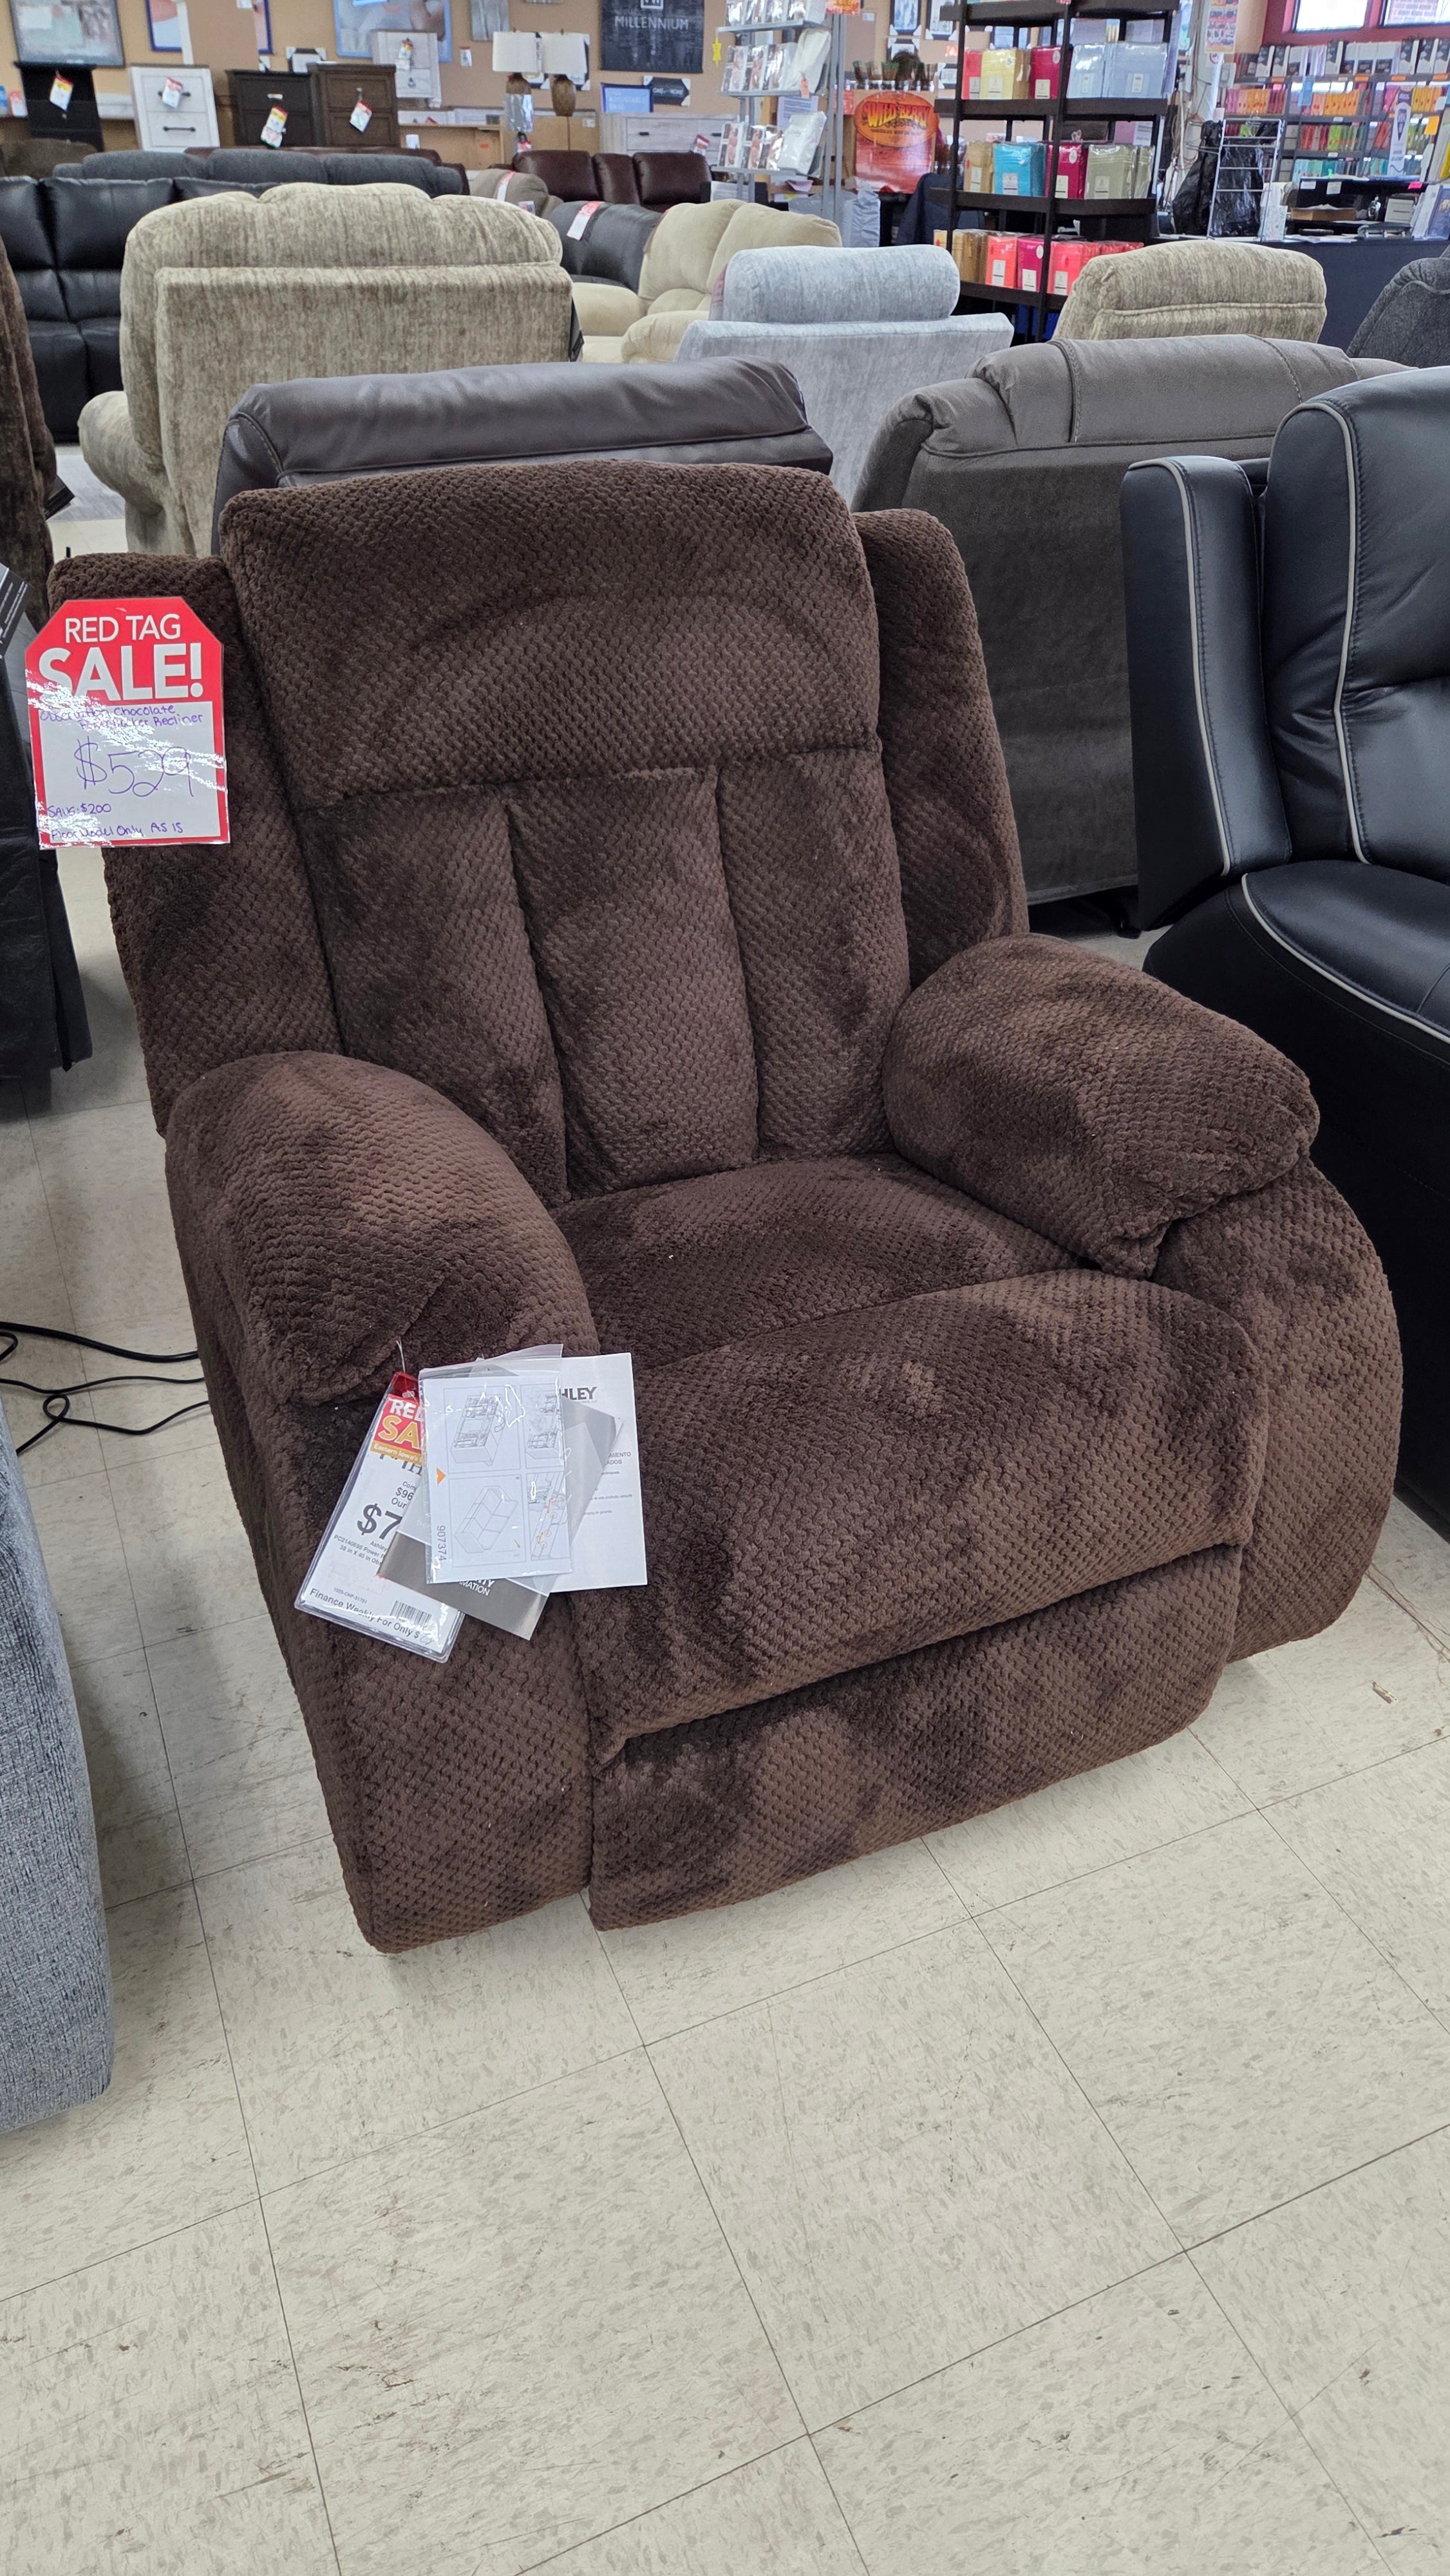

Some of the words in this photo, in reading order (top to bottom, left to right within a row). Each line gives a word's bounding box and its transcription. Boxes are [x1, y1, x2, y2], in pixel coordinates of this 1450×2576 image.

[614, 15, 690, 30] MILLENNIUM
[66, 617, 118, 643] RED
[126, 614, 181, 641] TAG
[39, 643, 203, 703] SALE!
[114, 705, 175, 716] Chocolate
[154, 714, 203, 727] Recliner
[74, 736, 194, 798] $529
[80, 803, 111, 815] $200
[391, 1497, 408, 1509] Our
[437, 1525, 447, 1561] 907374
[310, 1588, 344, 1607] Finance
[346, 1602, 375, 1622] Weekly
[393, 1622, 413, 1637] Only
